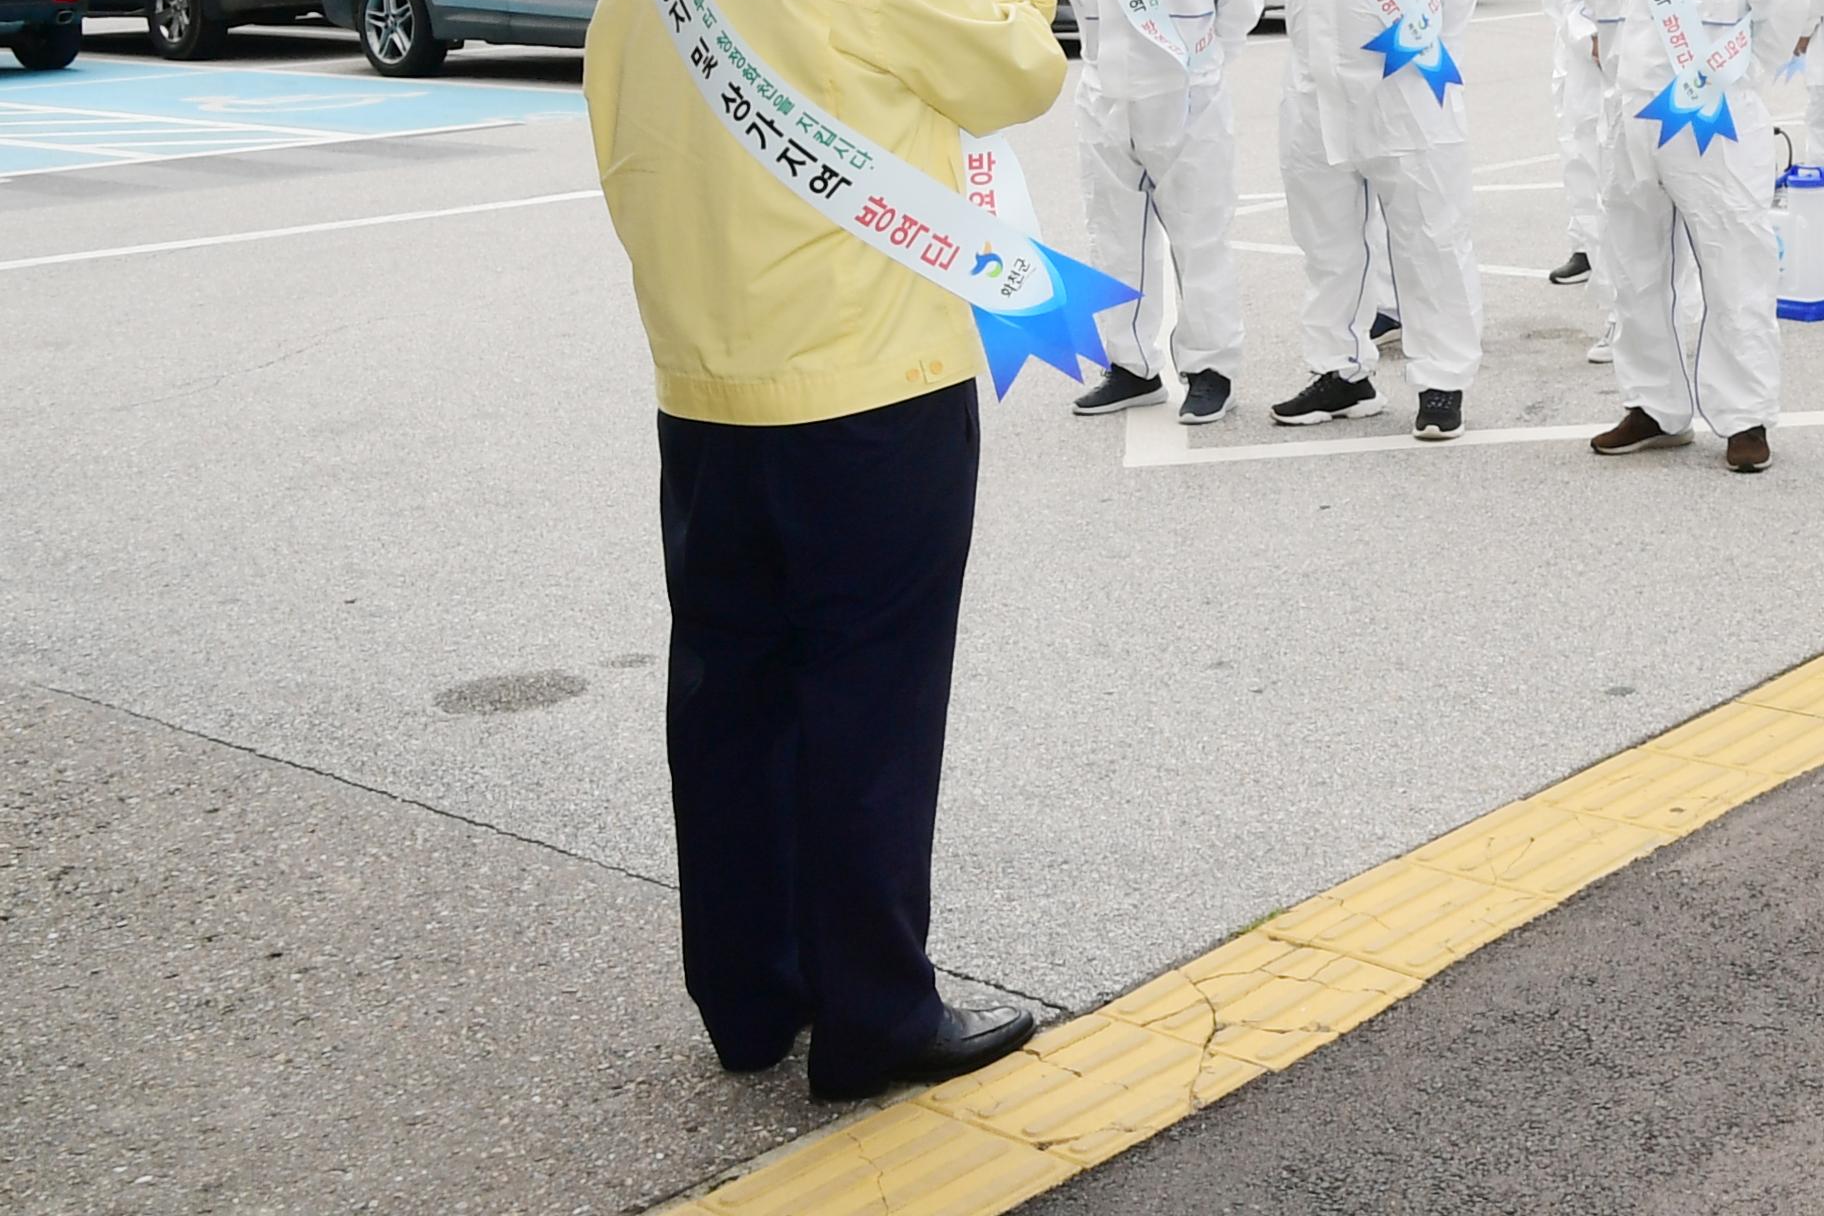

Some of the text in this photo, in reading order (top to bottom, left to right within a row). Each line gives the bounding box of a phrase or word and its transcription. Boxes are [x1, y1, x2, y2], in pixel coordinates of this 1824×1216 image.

[691, 37, 718, 79] 및
[720, 82, 853, 199] 상가지역
[854, 195, 961, 271] 방역단
[716, 31, 796, 115] 청정화천을
[796, 112, 875, 170] 지킵시다.
[1001, 257, 1031, 298] 화천군
